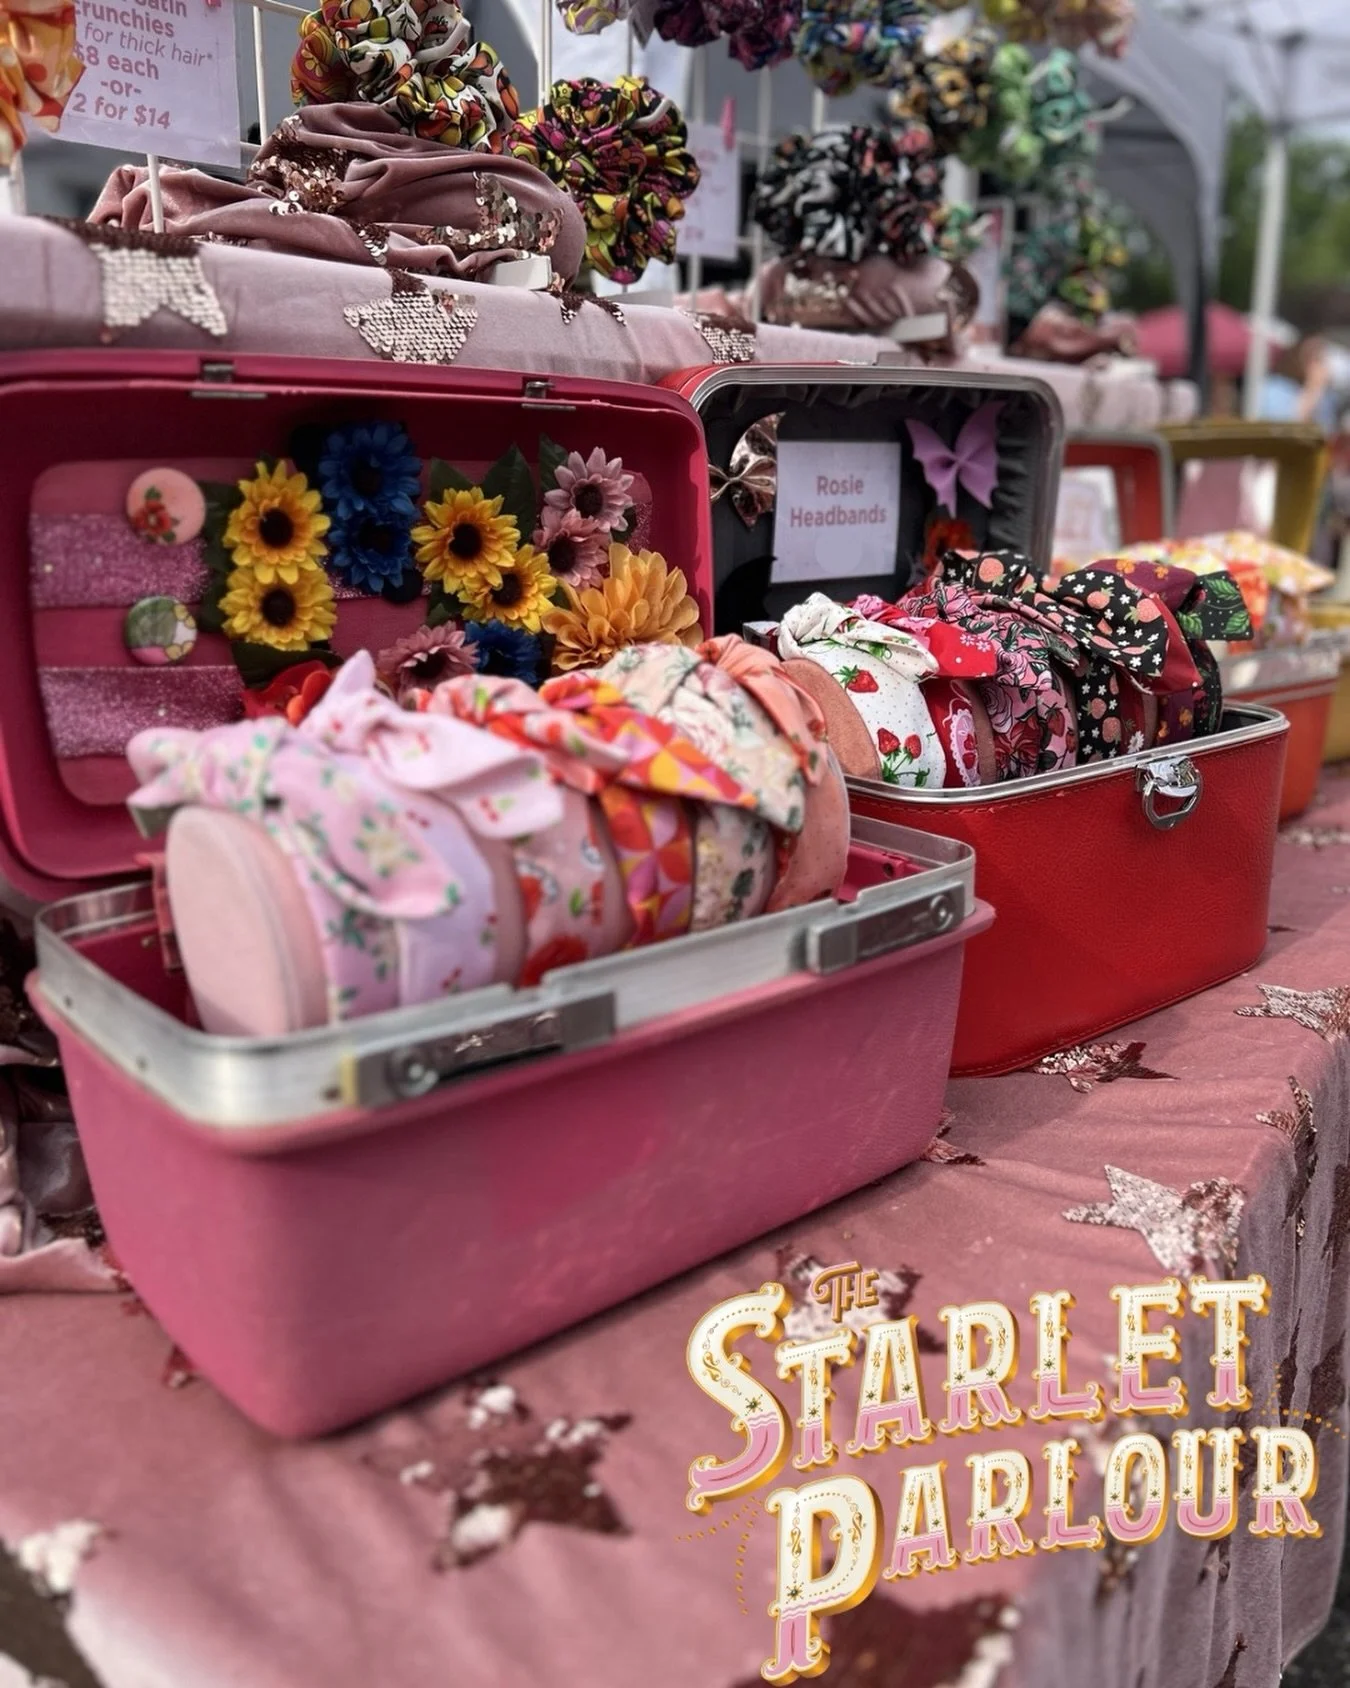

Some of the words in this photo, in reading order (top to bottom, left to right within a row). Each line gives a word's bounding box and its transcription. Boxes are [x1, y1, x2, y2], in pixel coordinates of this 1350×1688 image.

[84, 22, 114, 44] for
[119, 31, 166, 58] thick
[107, 54, 159, 80] each
[100, 79, 142, 98] -or-
[72, 92, 87, 113] 2
[94, 96, 128, 121] for
[134, 104, 171, 130] $14
[816, 474, 865, 496] Rosie
[789, 504, 887, 528] Headbands
